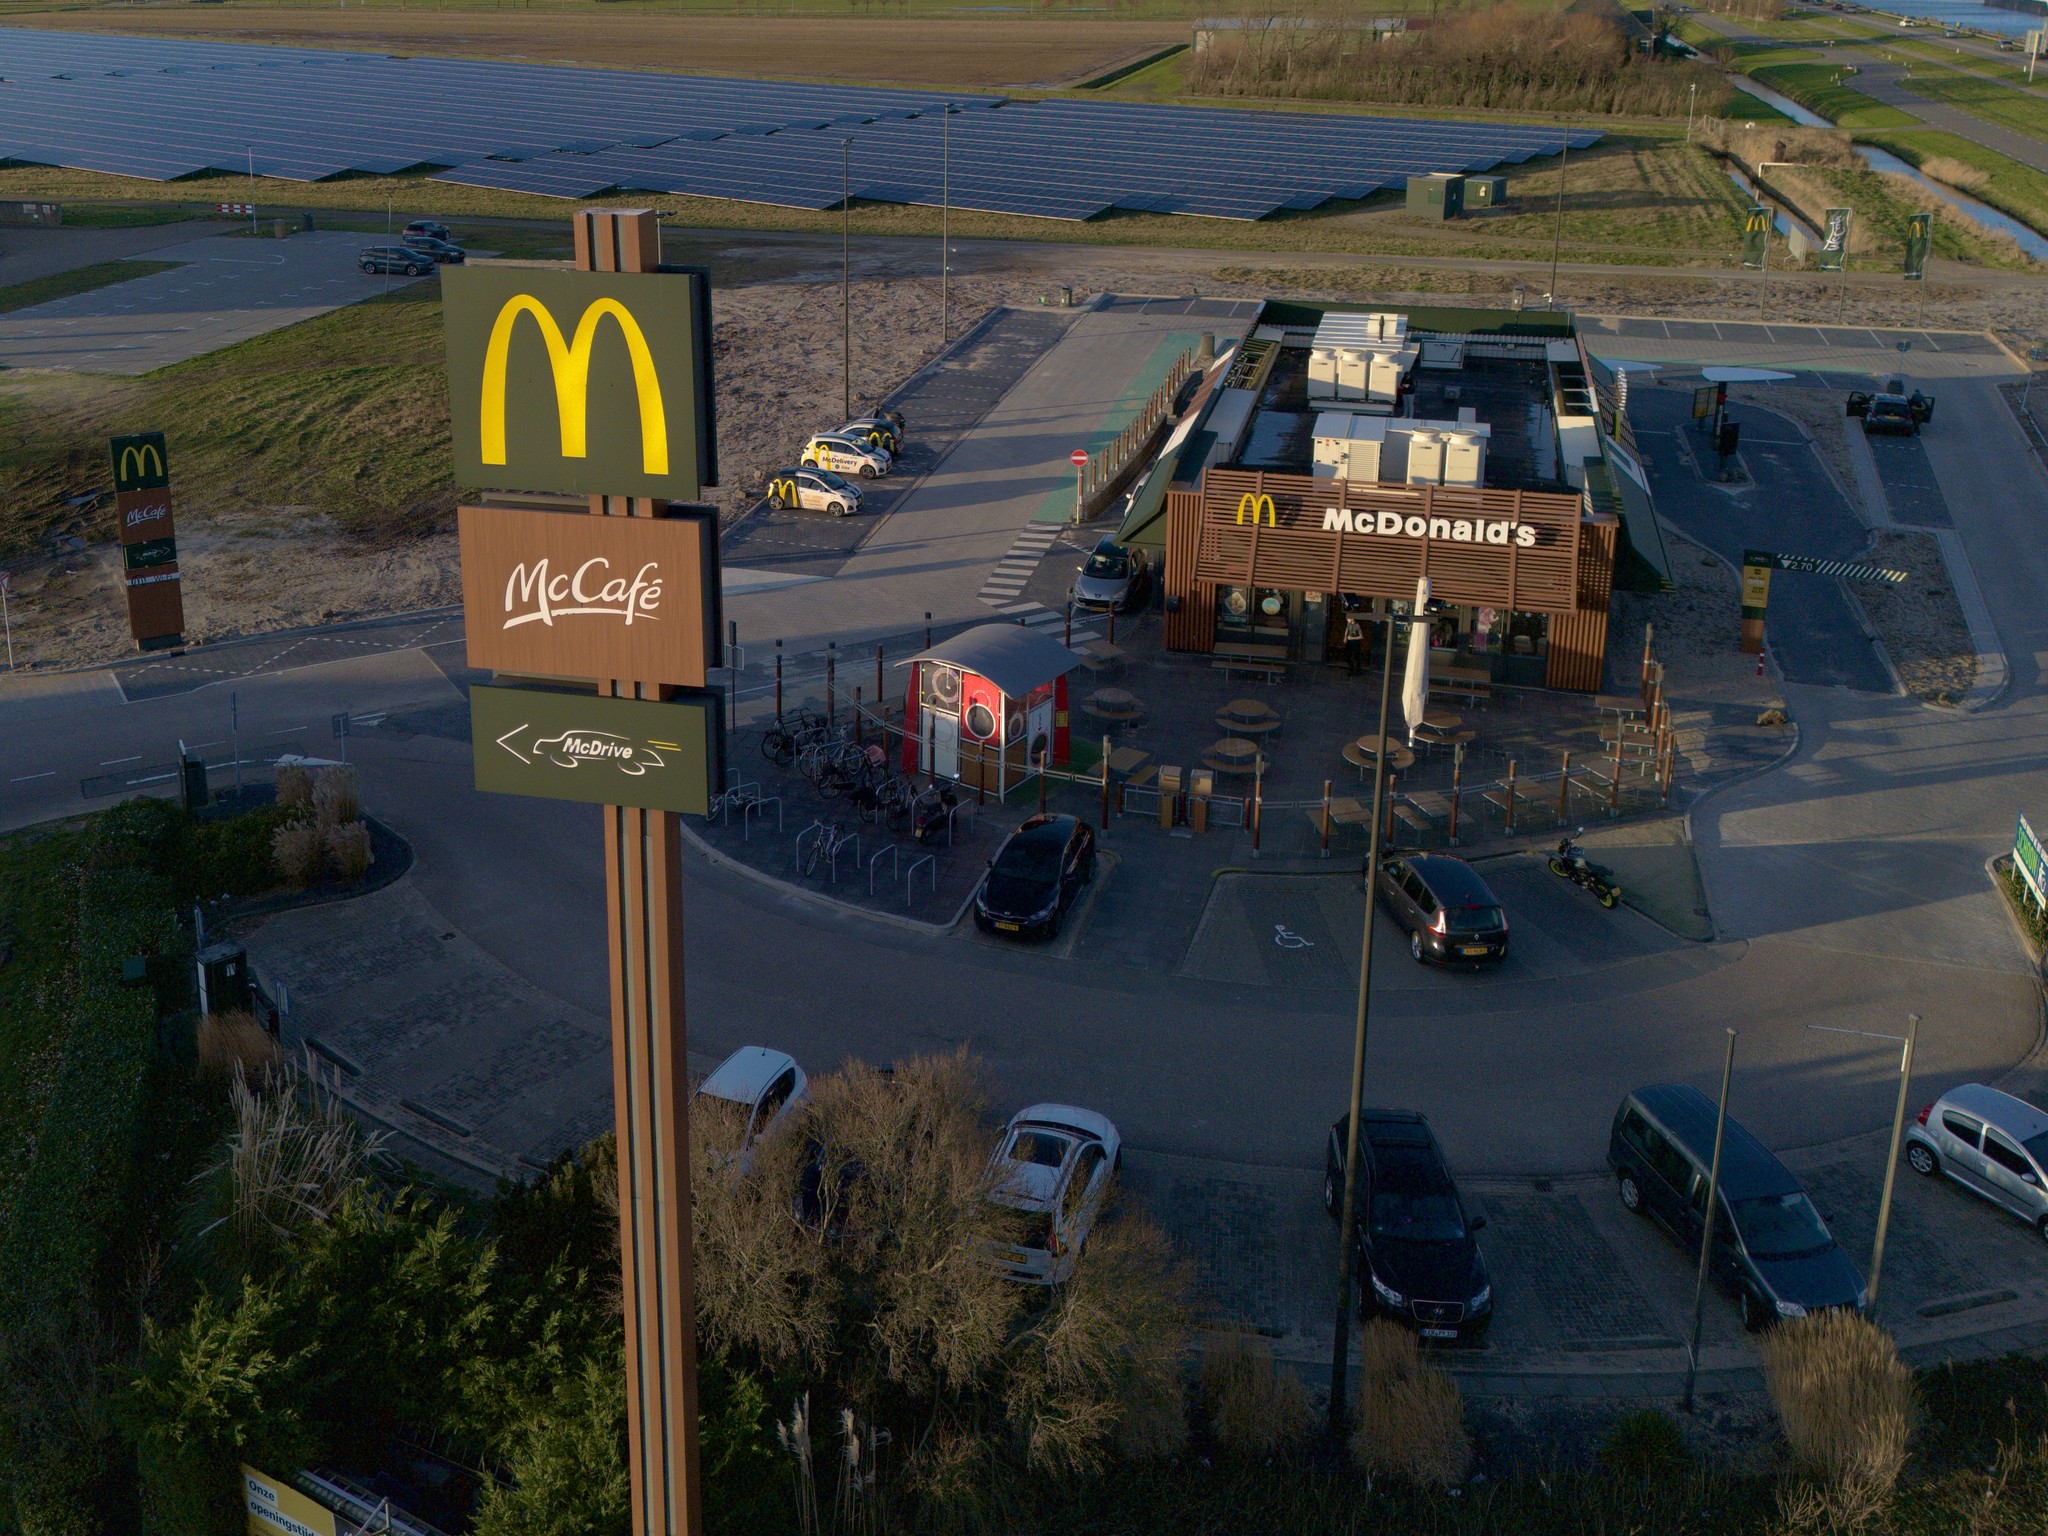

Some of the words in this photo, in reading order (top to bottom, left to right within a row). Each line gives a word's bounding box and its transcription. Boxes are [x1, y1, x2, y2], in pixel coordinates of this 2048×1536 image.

[822, 456, 858, 466] McDelivery
[126, 504, 166, 527] McCafé
[1321, 508, 1536, 547] McDonald's
[1791, 561, 1813, 571] 2.70
[502, 557, 663, 629] McCafé
[562, 737, 633, 759] McDrive
[248, 1479, 275, 1502] Onze
